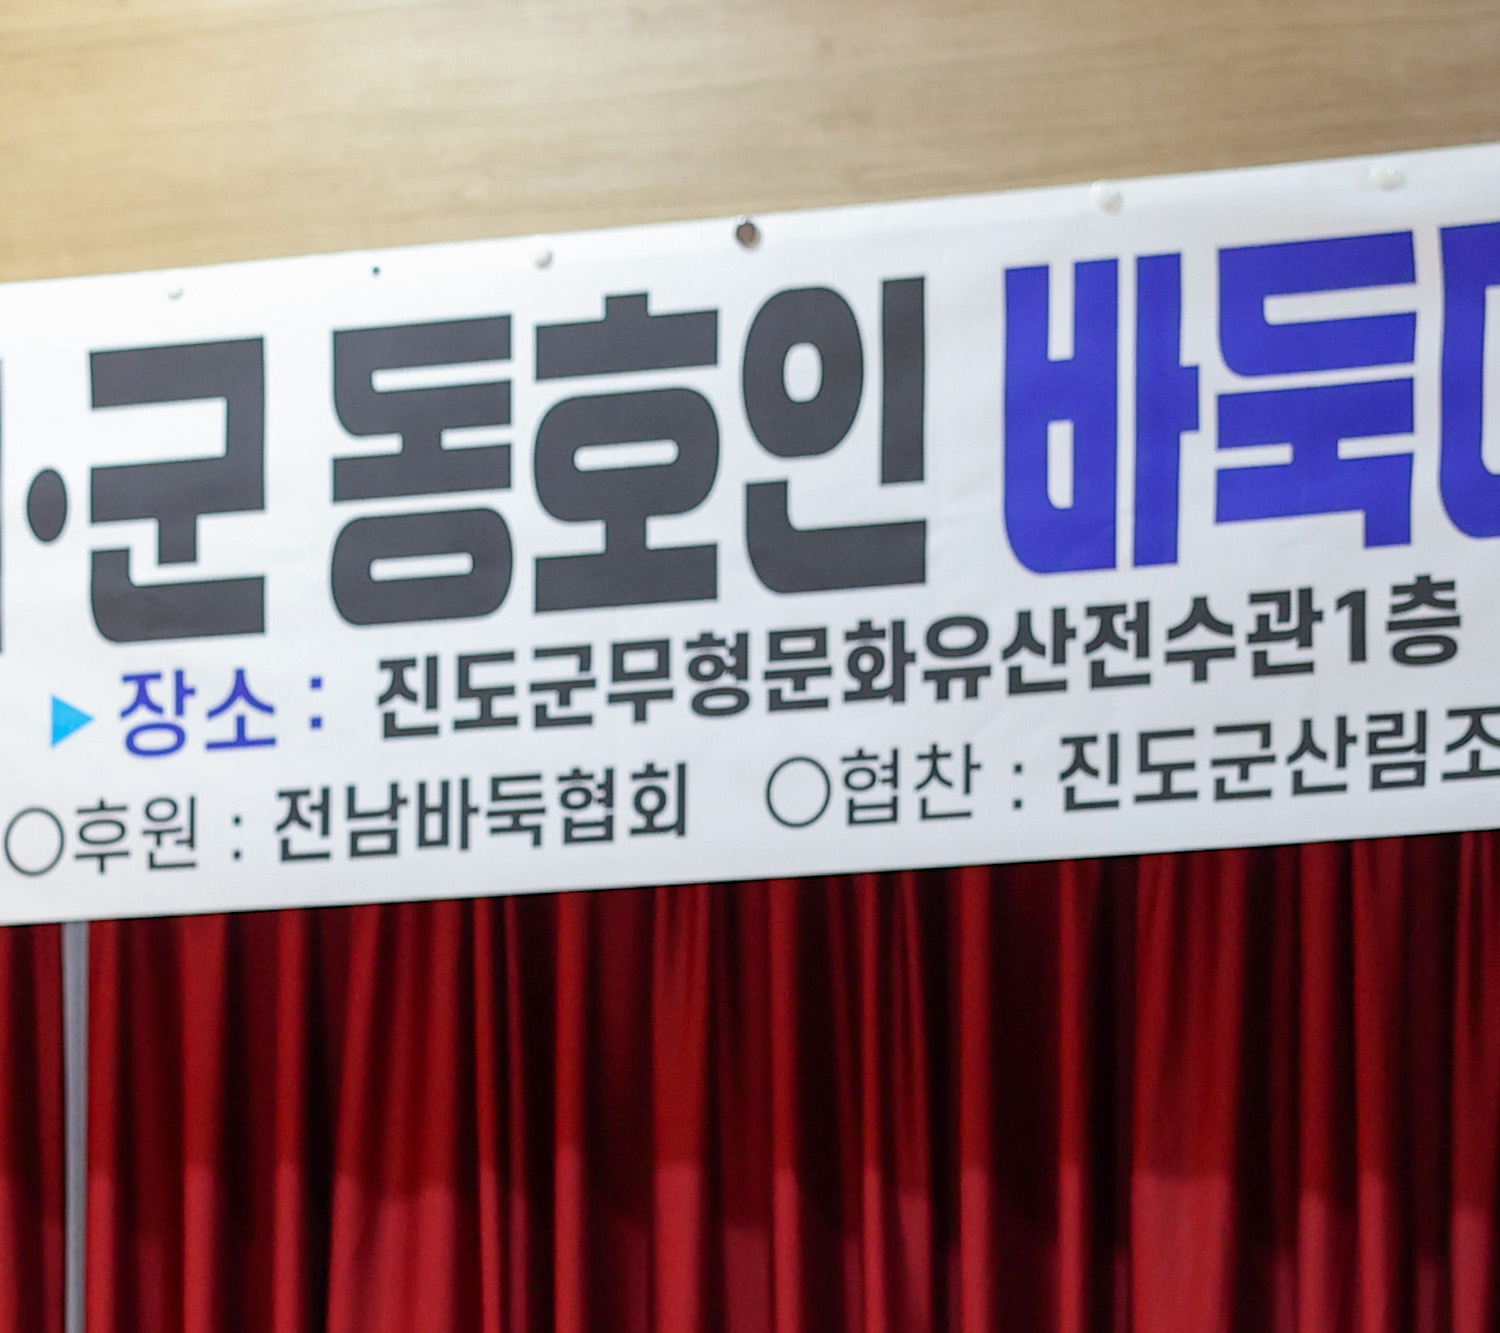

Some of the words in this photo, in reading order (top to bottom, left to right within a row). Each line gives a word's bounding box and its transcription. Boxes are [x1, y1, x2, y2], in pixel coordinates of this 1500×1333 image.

[328, 274, 929, 629] 동호인
[119, 667, 277, 759] 장소
[376, 573, 1462, 740] 진도군무형문화유산전수관1층
[274, 761, 688, 863] 전남바둑협회
